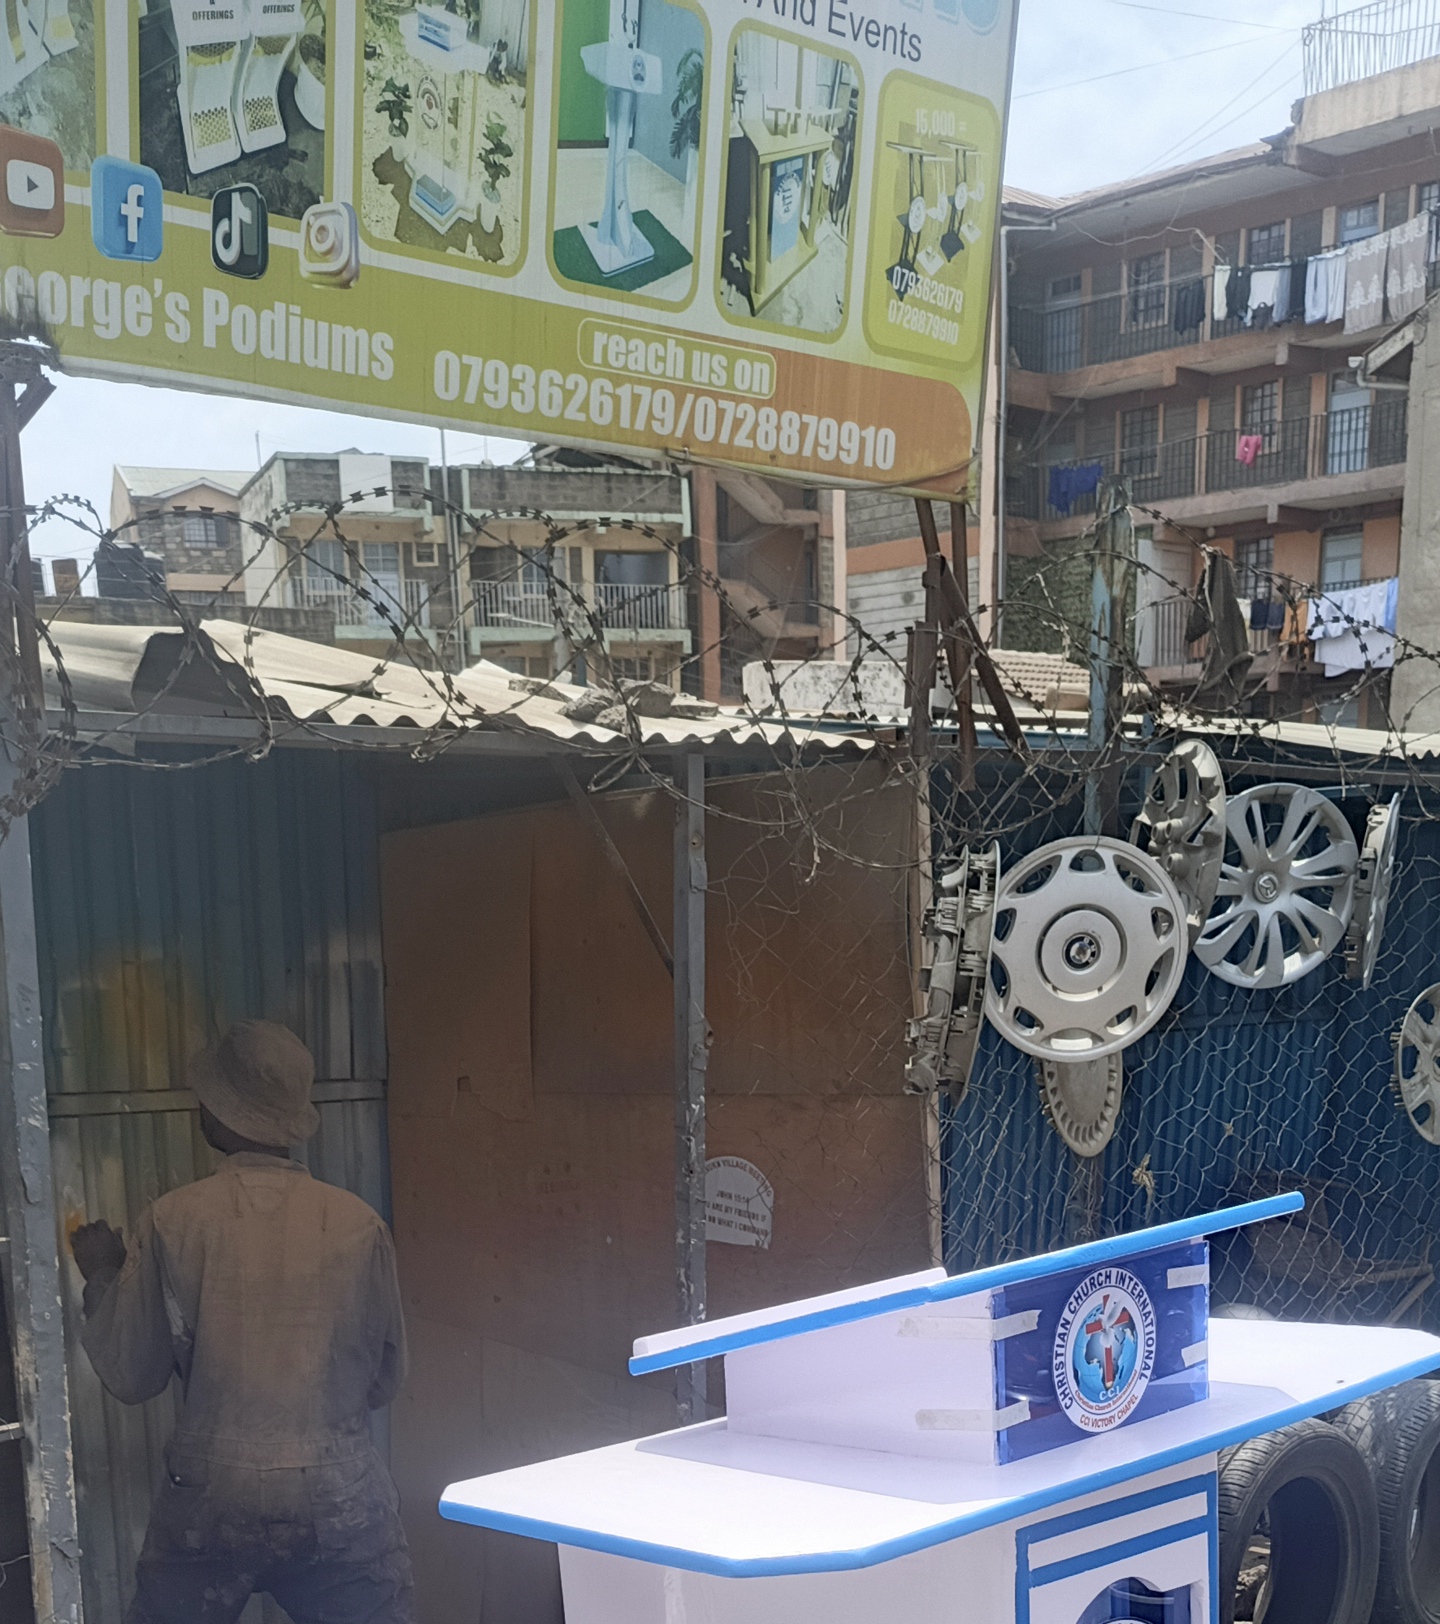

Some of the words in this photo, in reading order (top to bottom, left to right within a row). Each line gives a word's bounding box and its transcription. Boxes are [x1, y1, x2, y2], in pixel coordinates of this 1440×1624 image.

[192, 10, 234, 21] OFFERINGS
[262, 4, 295, 14] OFFERINGS
[757, 0, 816, 26] nd
[828, 0, 921, 62] Events
[892, 266, 963, 313] 0793626179
[202, 287, 394, 381] Podiums
[888, 299, 959, 345] 0728879910
[593, 331, 685, 380] reach
[691, 350, 728, 387] us
[733, 359, 770, 394] on
[433, 350, 896, 470] 0793626179/0728879910
[1054, 1318, 1073, 1410] CHRISTIAN
[1068, 1271, 1112, 1315] CHURCH
[1115, 1270, 1156, 1381] INTERNATIONAL
[1080, 1414, 1090, 1426] CCI
[1091, 1413, 1116, 1429] VICTORY
[1117, 1393, 1138, 1420] CHAPEL
